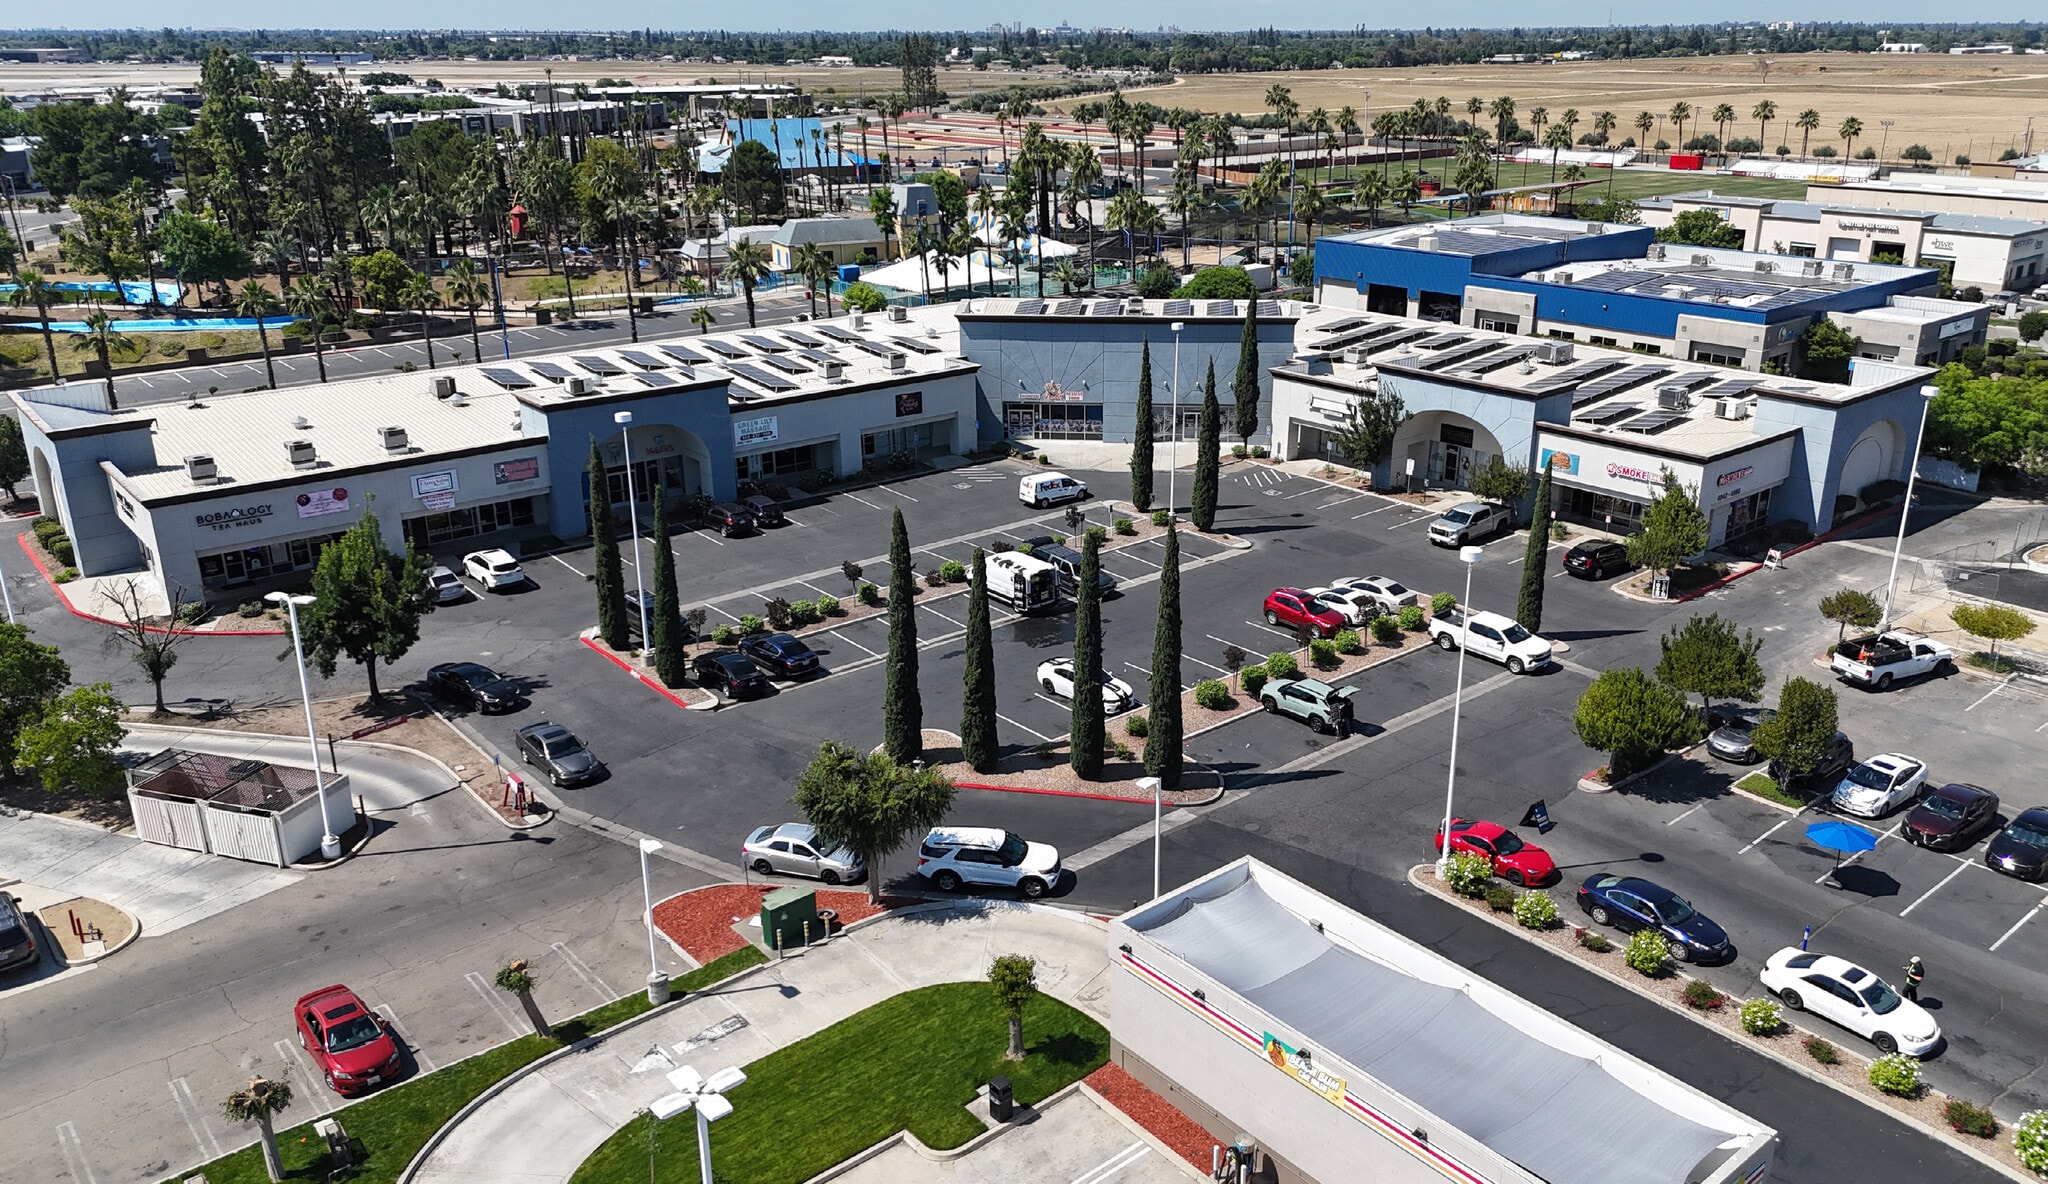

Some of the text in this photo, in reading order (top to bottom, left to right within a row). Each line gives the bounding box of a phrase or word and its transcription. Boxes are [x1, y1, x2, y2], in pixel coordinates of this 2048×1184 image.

[760, 417, 773, 425] LILY
[741, 425, 770, 434] MASSAGE
[1617, 466, 1647, 480] SMOKE
[1040, 480, 1061, 492] FedEx
[236, 518, 262, 528] HAUS
[1318, 1071, 1341, 1093] BUM
